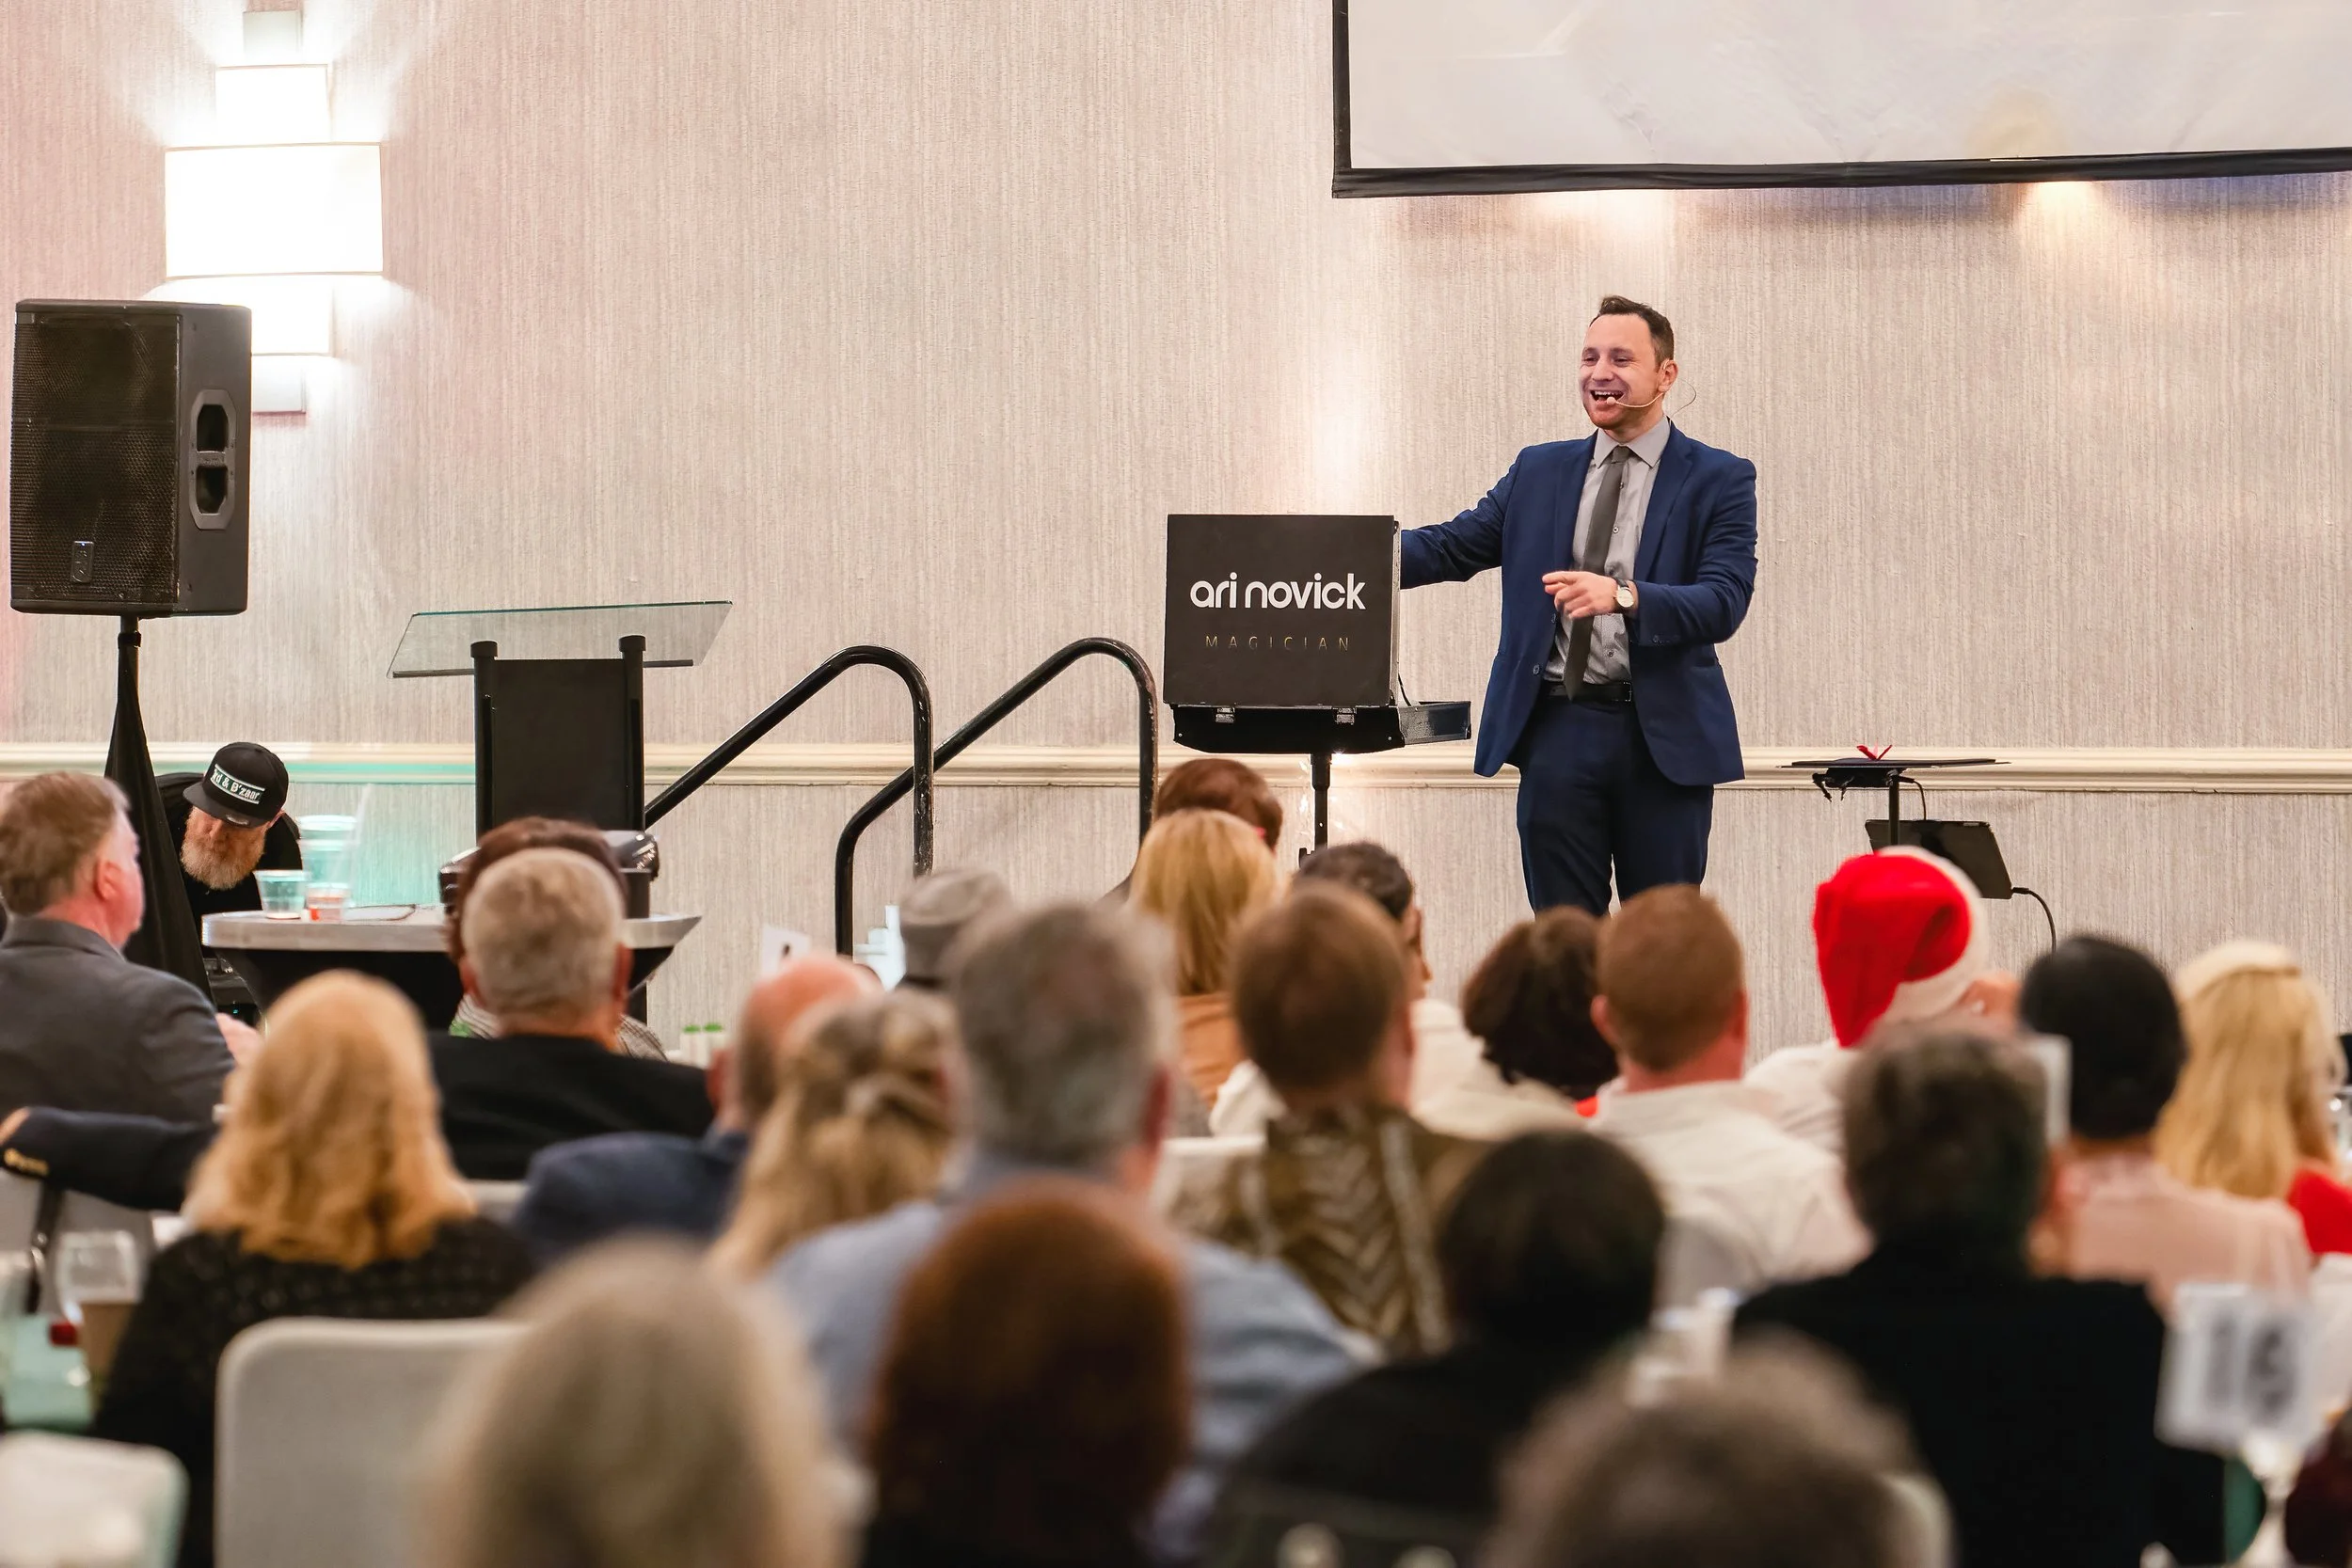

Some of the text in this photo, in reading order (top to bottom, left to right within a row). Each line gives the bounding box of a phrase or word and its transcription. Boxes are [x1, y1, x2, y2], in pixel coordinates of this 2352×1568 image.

[1190, 572, 1366, 610] ari novick
[1205, 635, 1350, 652] MAGICIAN
